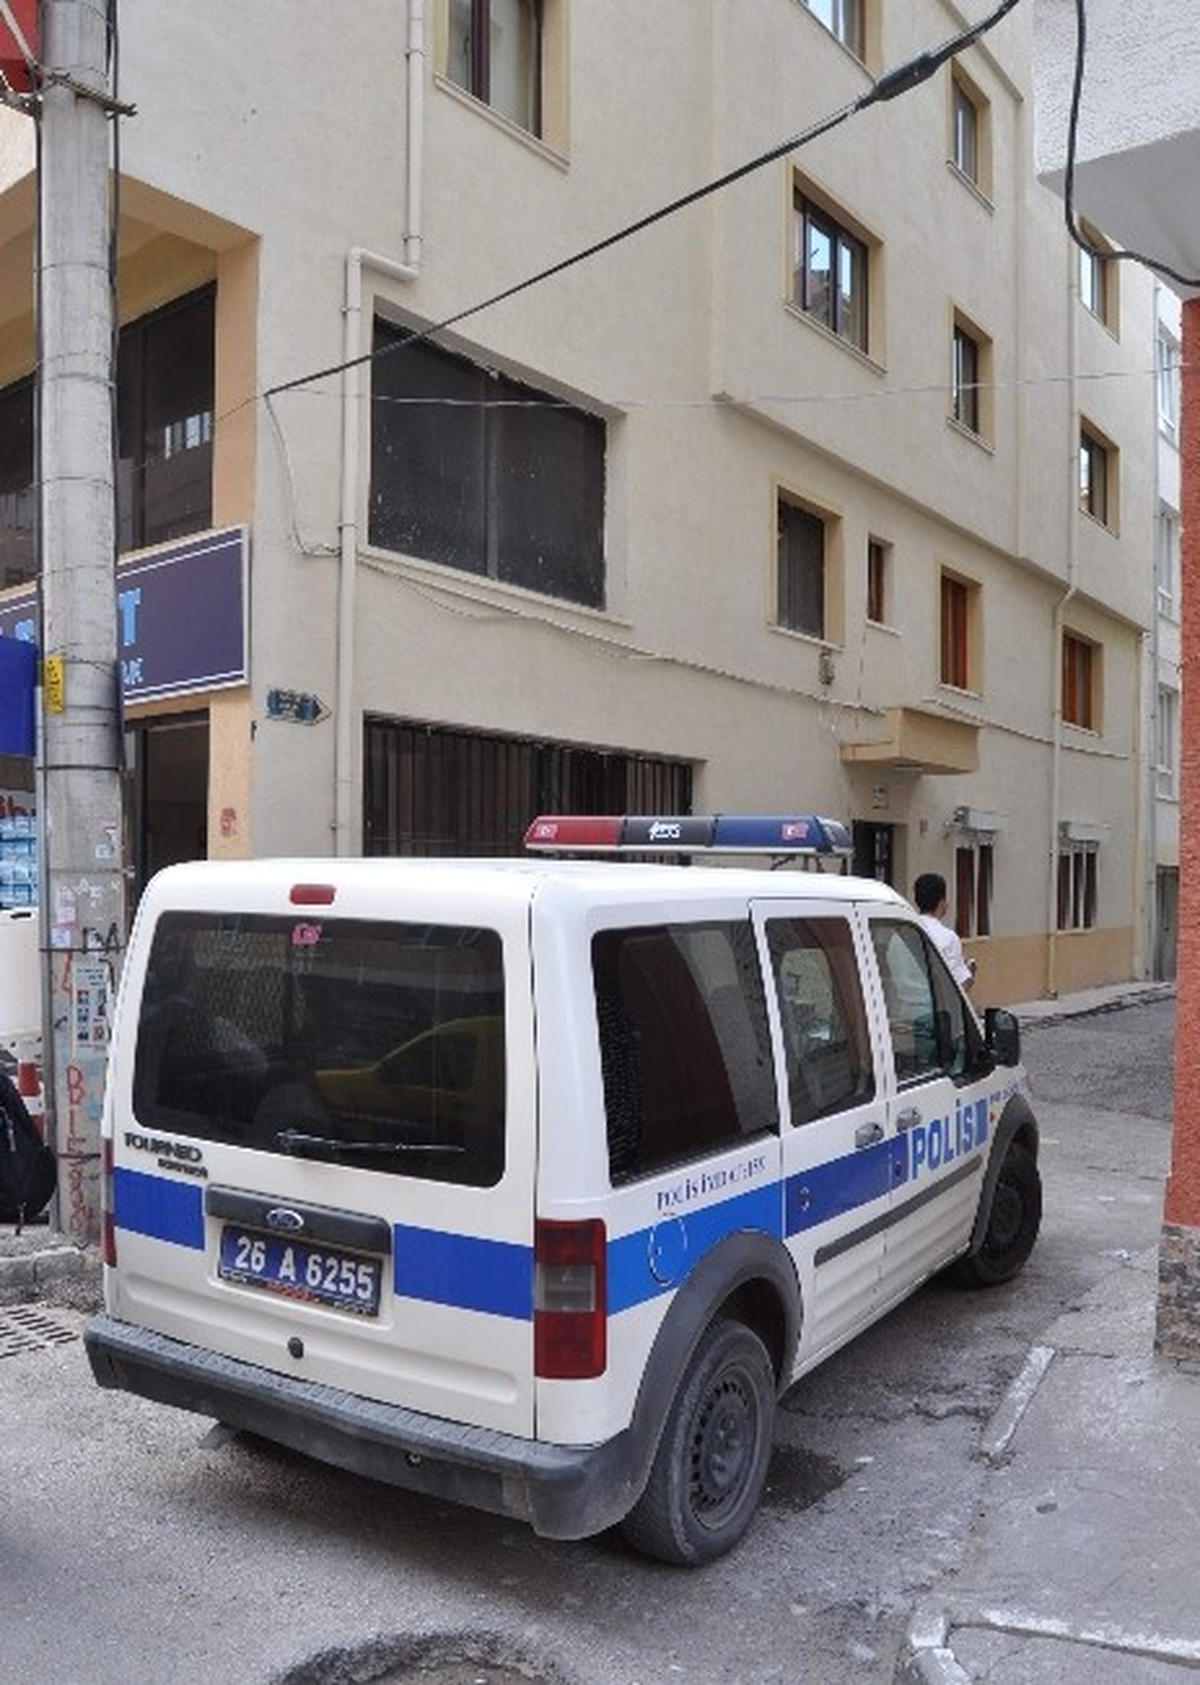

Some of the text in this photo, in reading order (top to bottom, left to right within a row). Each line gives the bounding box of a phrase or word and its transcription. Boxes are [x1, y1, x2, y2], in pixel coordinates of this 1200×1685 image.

[911, 1097, 974, 1180] POLİS
[234, 1235, 266, 1273] 26
[279, 1247, 297, 1282] A
[305, 1253, 374, 1300] 6255
